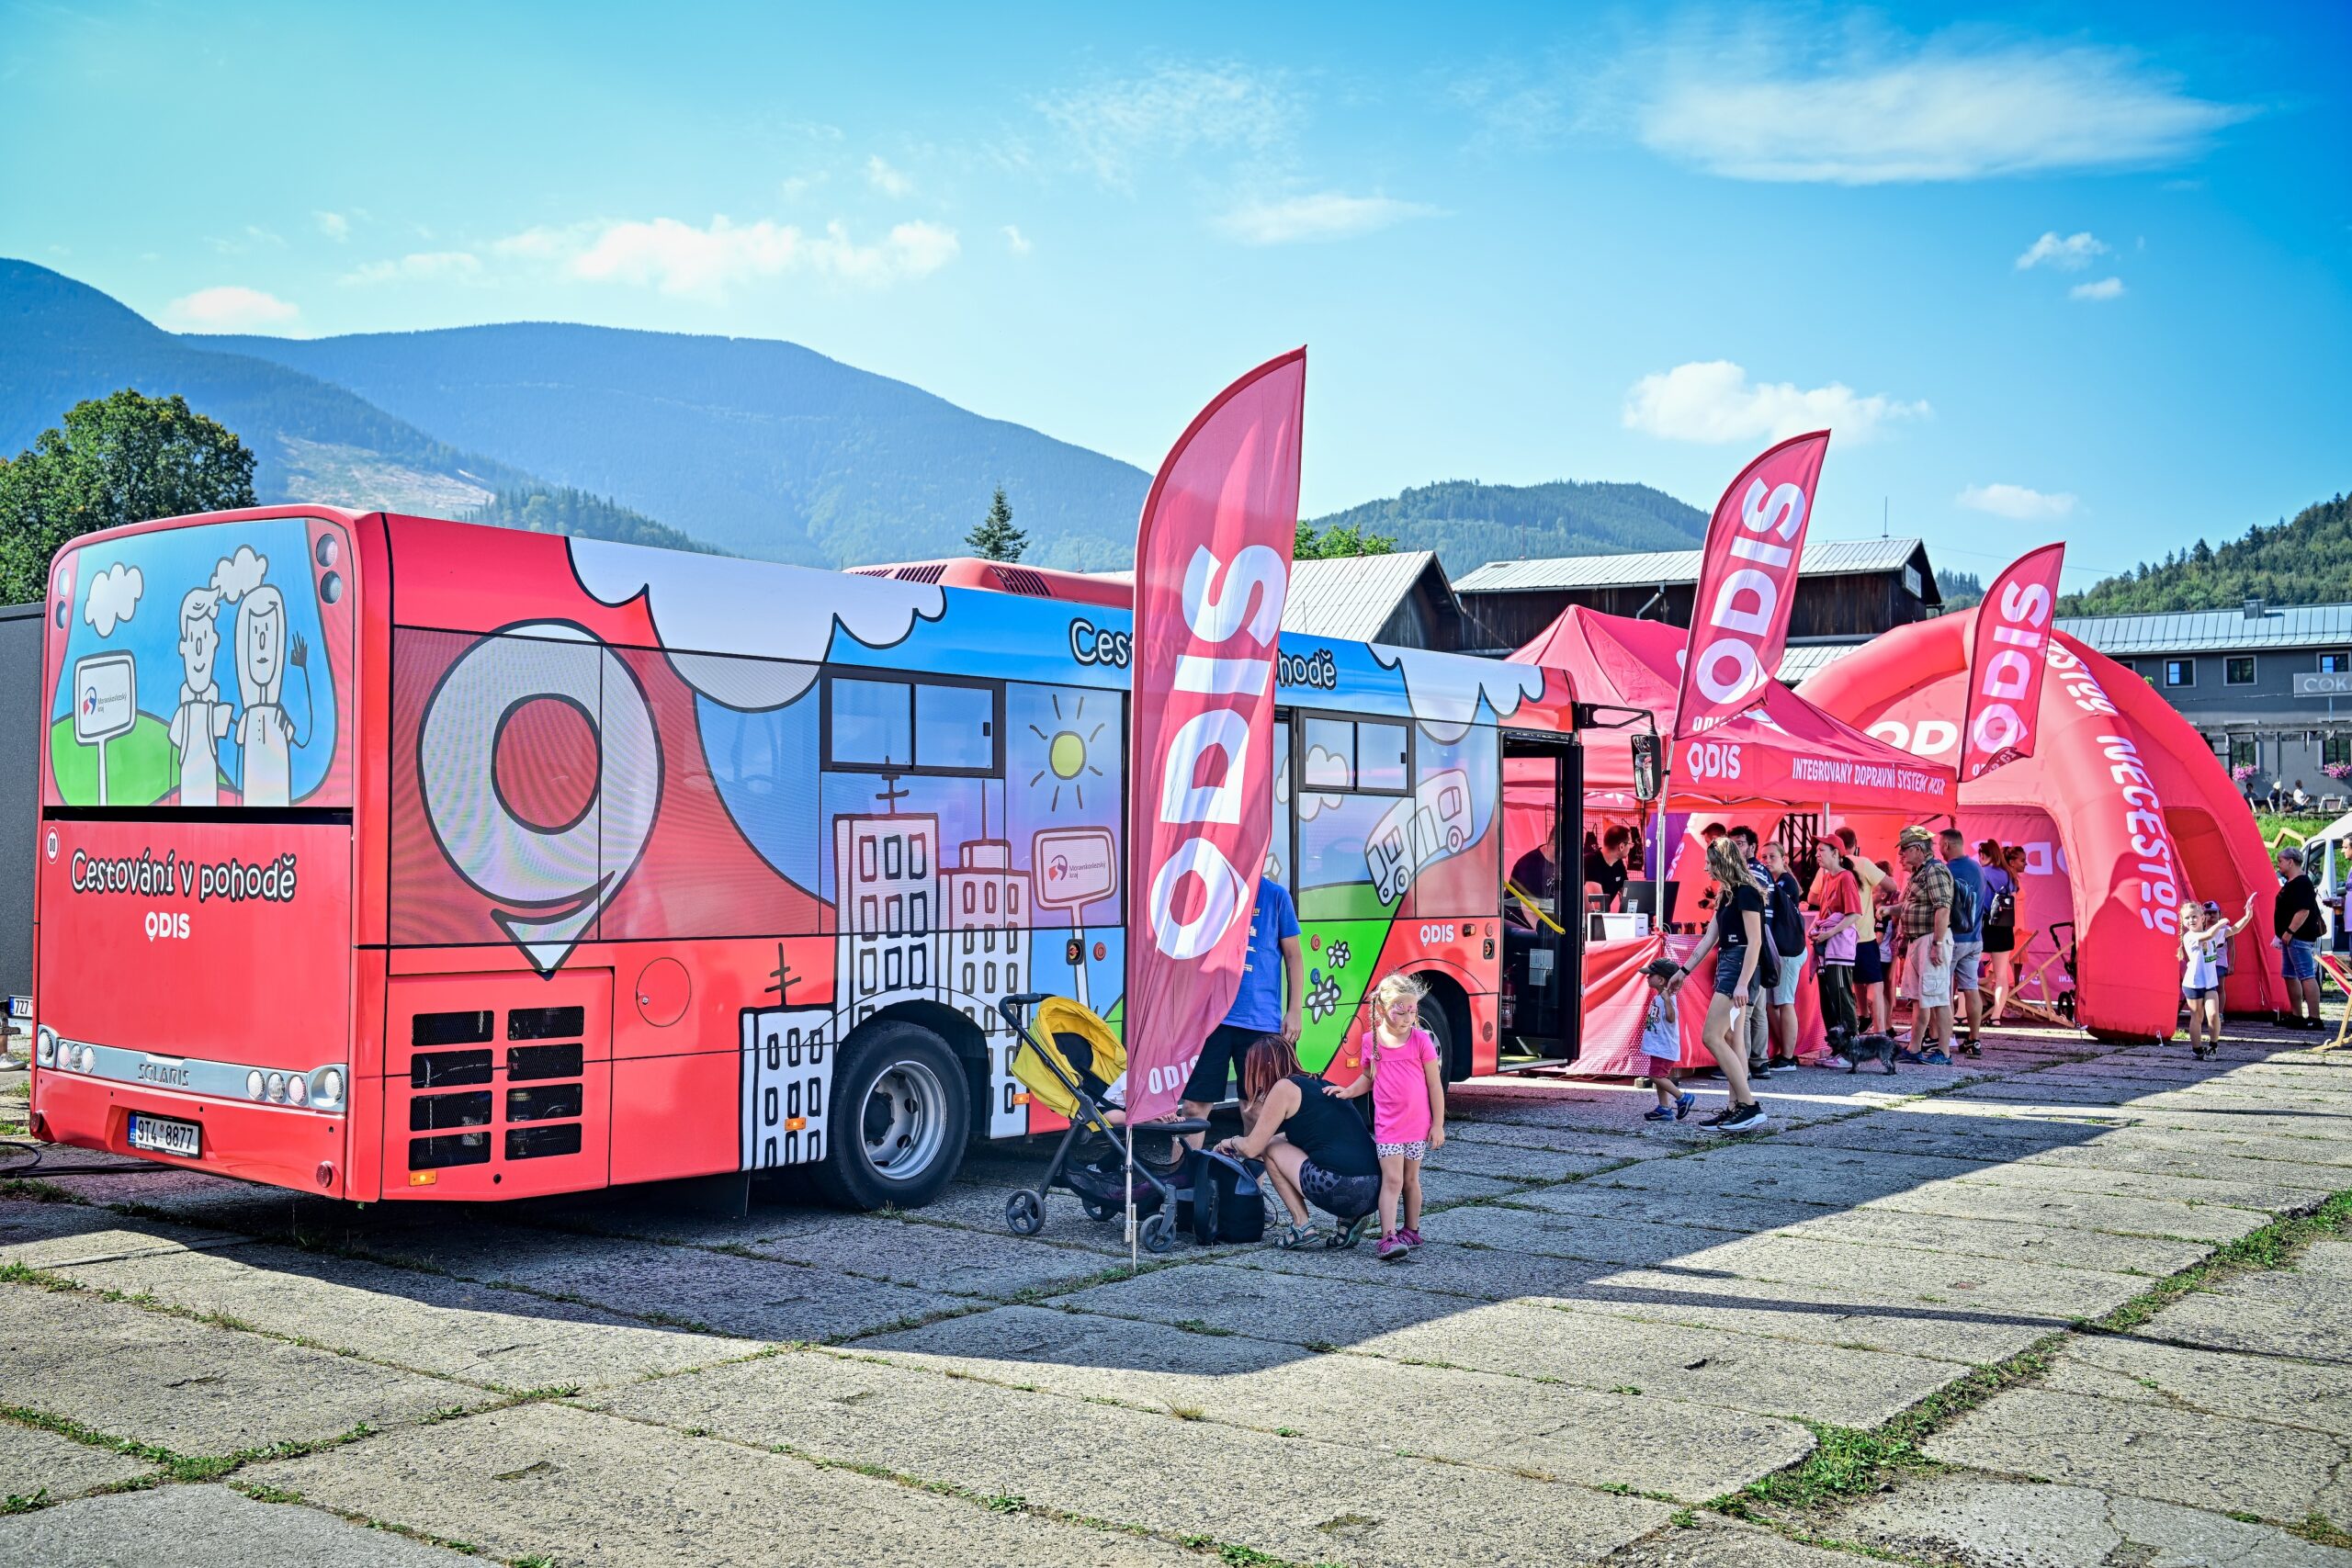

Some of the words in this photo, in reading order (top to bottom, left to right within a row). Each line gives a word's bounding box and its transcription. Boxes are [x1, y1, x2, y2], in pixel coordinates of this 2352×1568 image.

[1696, 477, 1806, 705] ODIS
[1973, 580, 2051, 754] ODIS
[1150, 544, 1287, 960] ODIS
[1687, 742, 1742, 784] ODIS
[49, 838, 56, 852] 80
[72, 847, 175, 897] Cestování
[179, 860, 195, 897] v
[198, 852, 298, 903] pohodě
[145, 911, 190, 942] ODIS
[1419, 924, 1455, 947] ODIS
[138, 1064, 189, 1087] SOLARIS
[138, 1120, 157, 1145] 9T4
[165, 1124, 194, 1150] 8877
